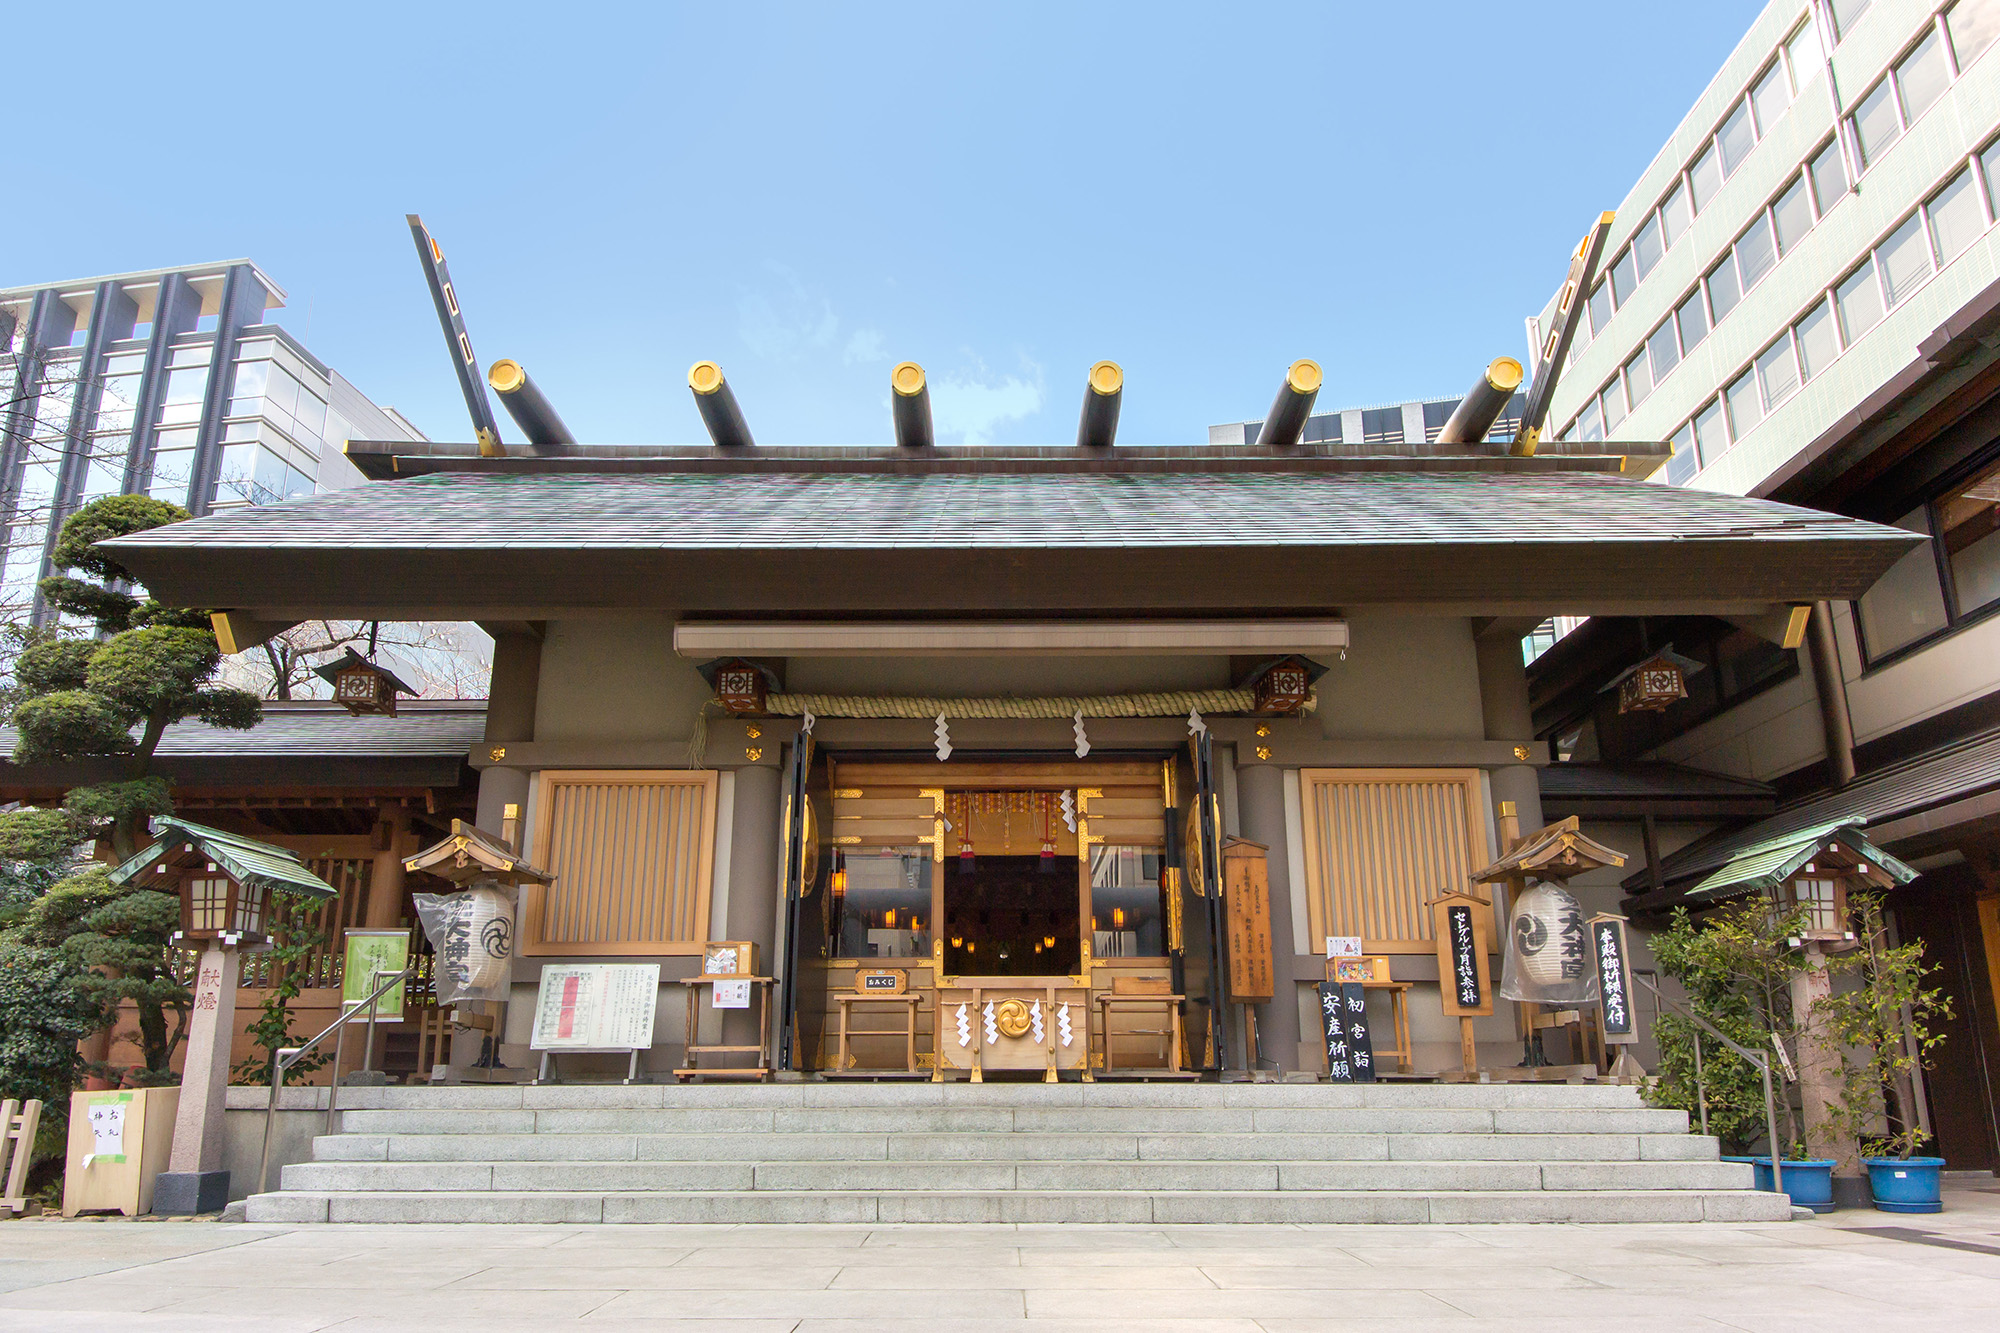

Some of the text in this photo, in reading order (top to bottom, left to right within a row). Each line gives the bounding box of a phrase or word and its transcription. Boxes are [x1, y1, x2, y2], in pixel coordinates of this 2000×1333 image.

[1600, 928, 1625, 1026] 本殿御祈願受付
[1323, 991, 1352, 1079] 安産祈願
[1347, 996, 1369, 1068] 初宮詣
